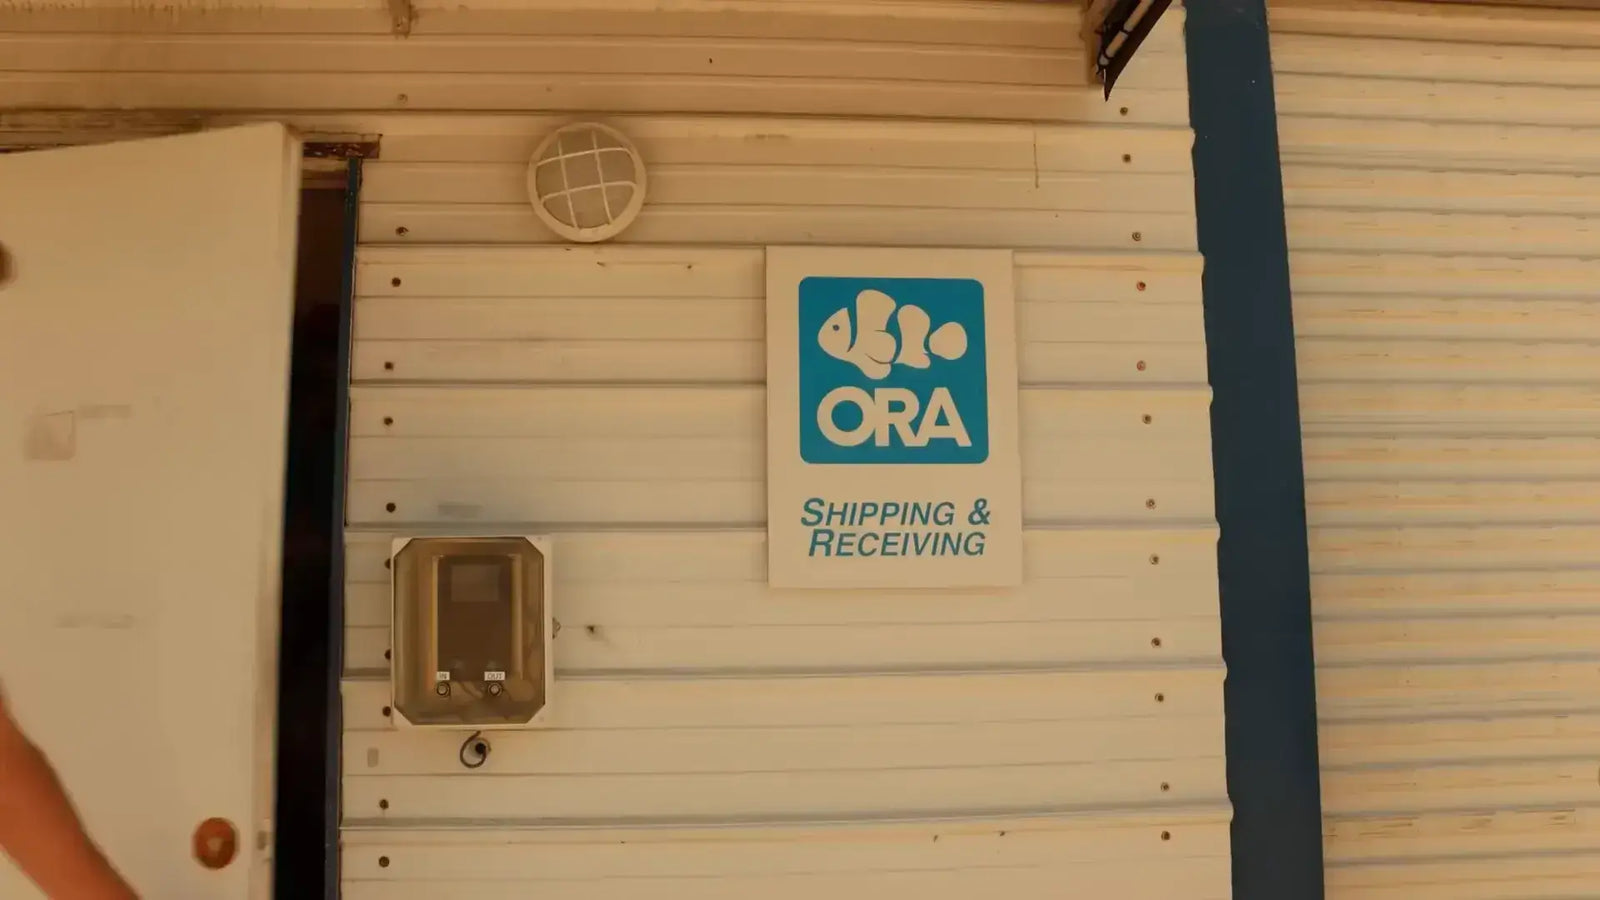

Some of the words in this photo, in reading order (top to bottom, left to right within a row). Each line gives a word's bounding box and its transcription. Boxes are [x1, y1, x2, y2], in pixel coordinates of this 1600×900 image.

[817, 386, 972, 447] ORA
[800, 498, 956, 526] SHIPPING
[967, 498, 991, 526] &
[808, 528, 986, 557] RECEIVING
